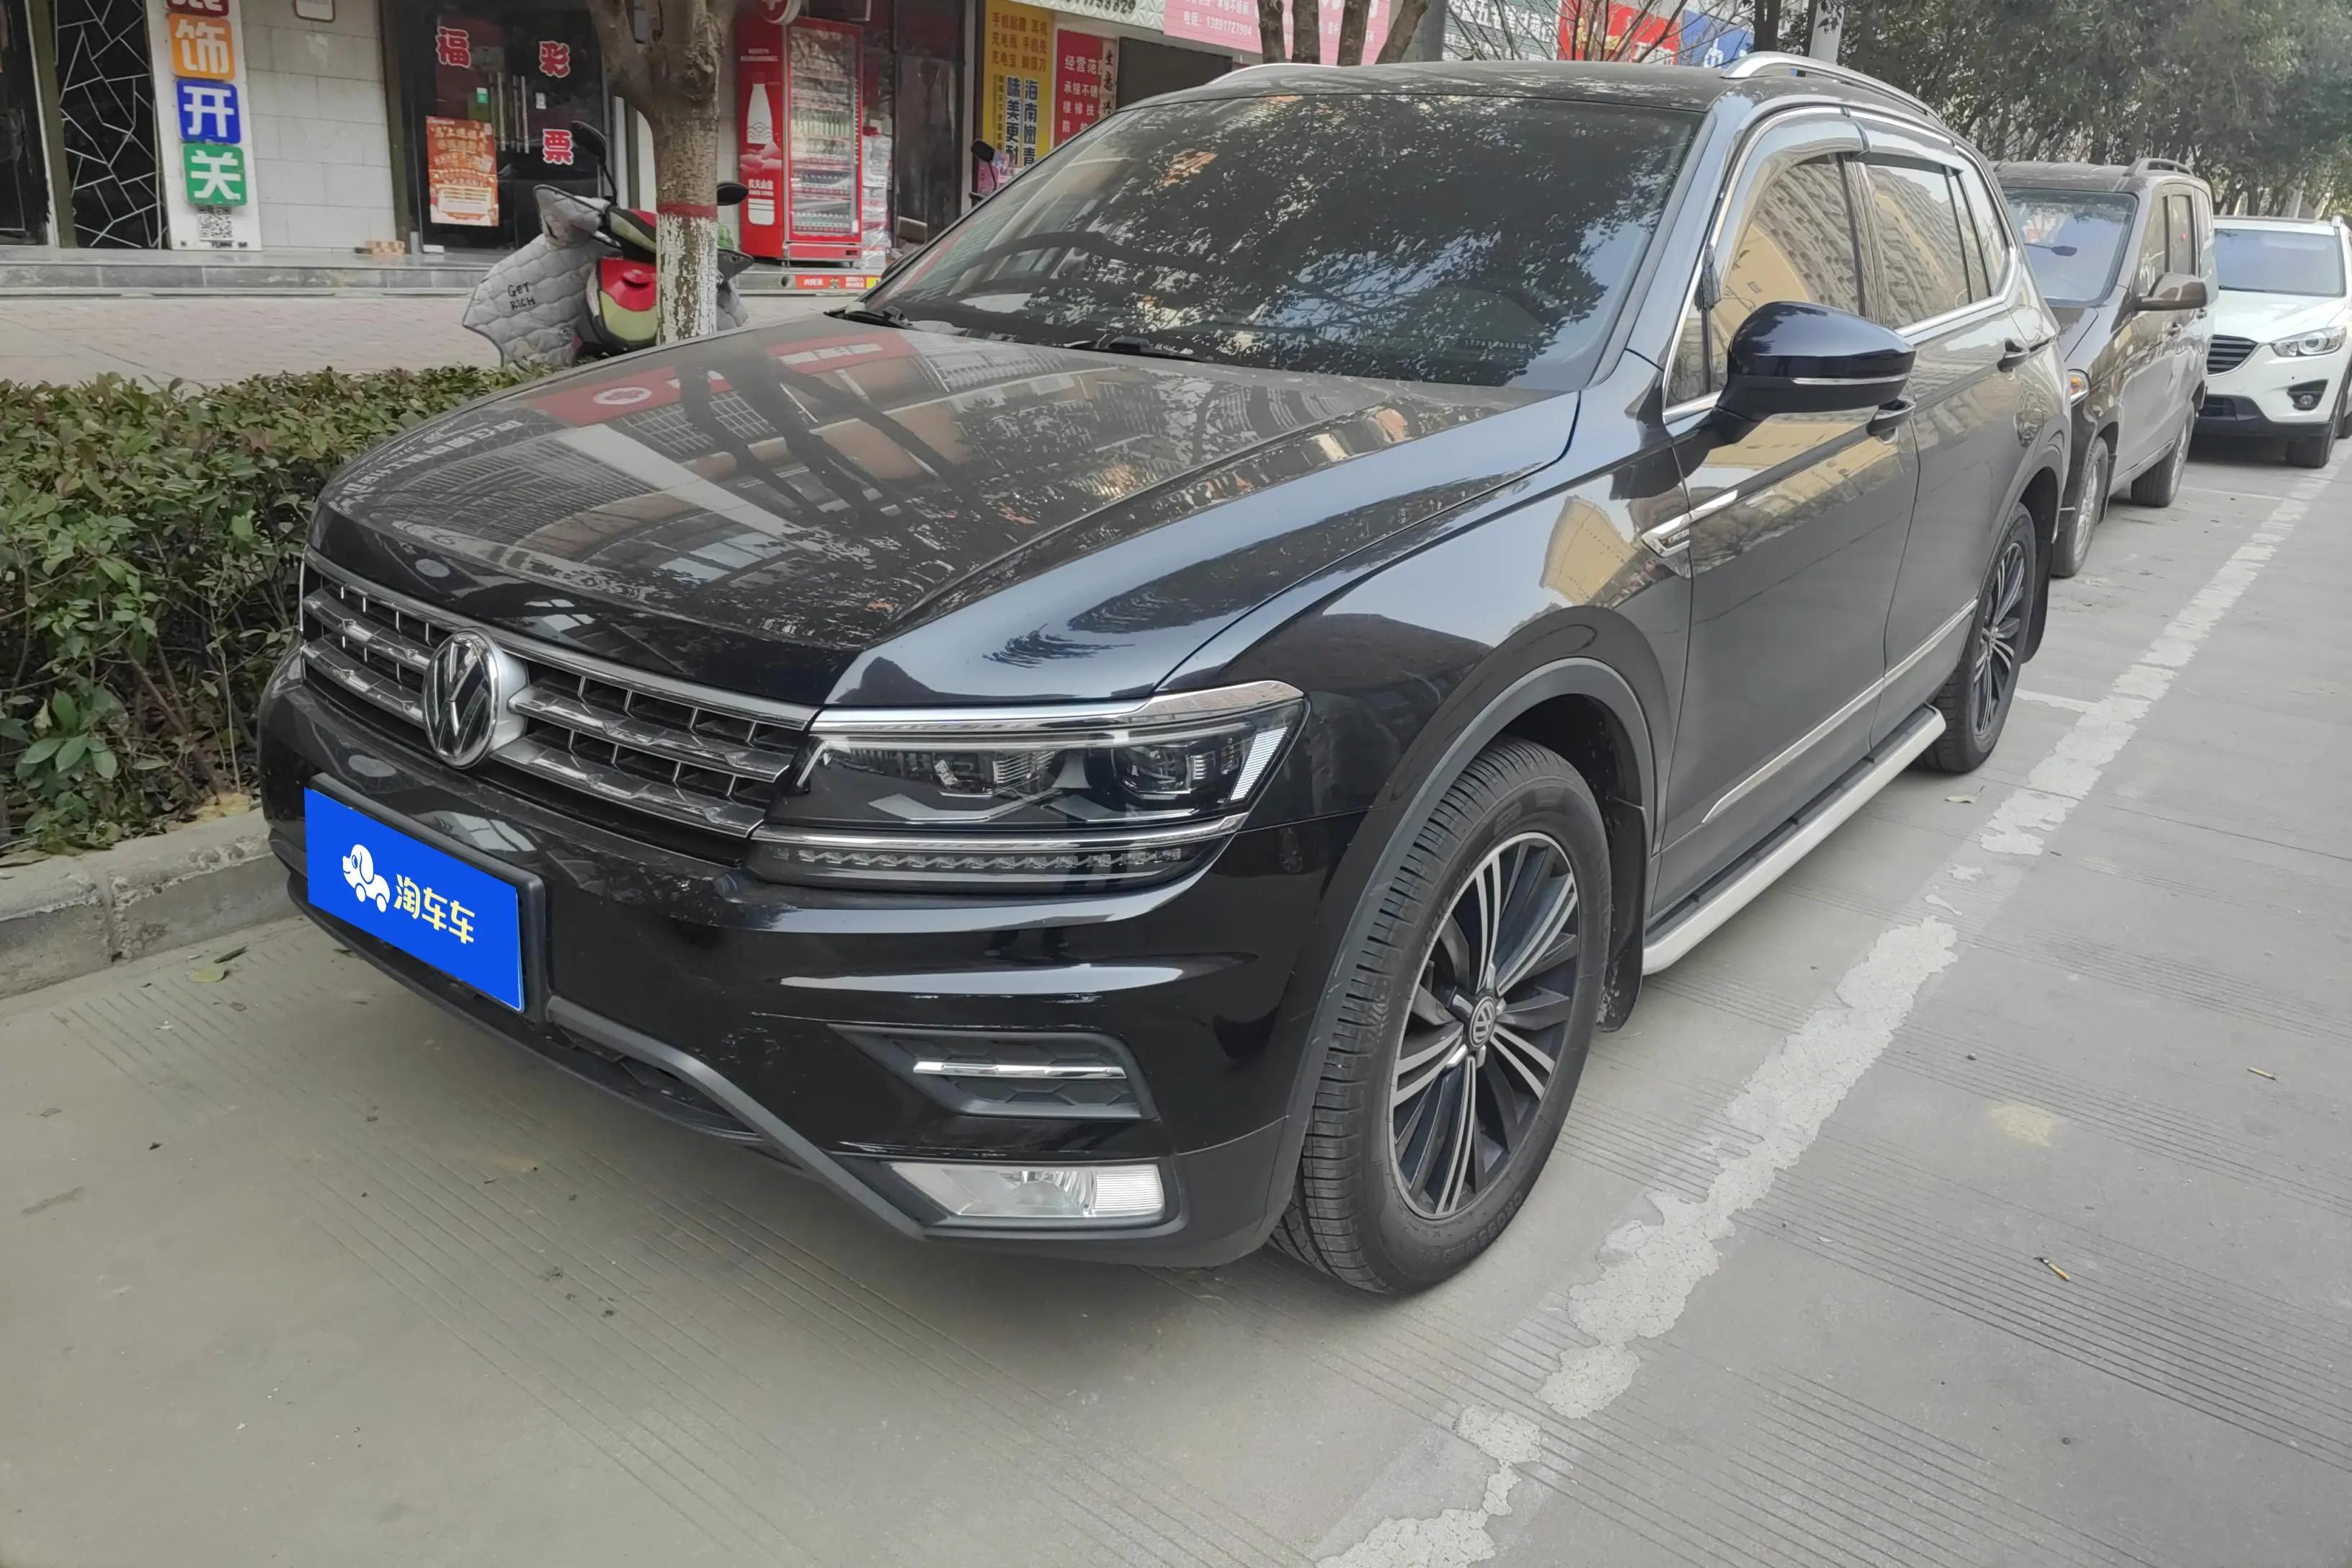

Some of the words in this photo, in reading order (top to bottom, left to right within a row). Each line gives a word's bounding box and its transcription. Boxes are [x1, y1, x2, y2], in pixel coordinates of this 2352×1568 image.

[437, 27, 471, 68] 福
[1065, 55, 1105, 75] 经营范
[172, 0, 241, 200] 饰开关
